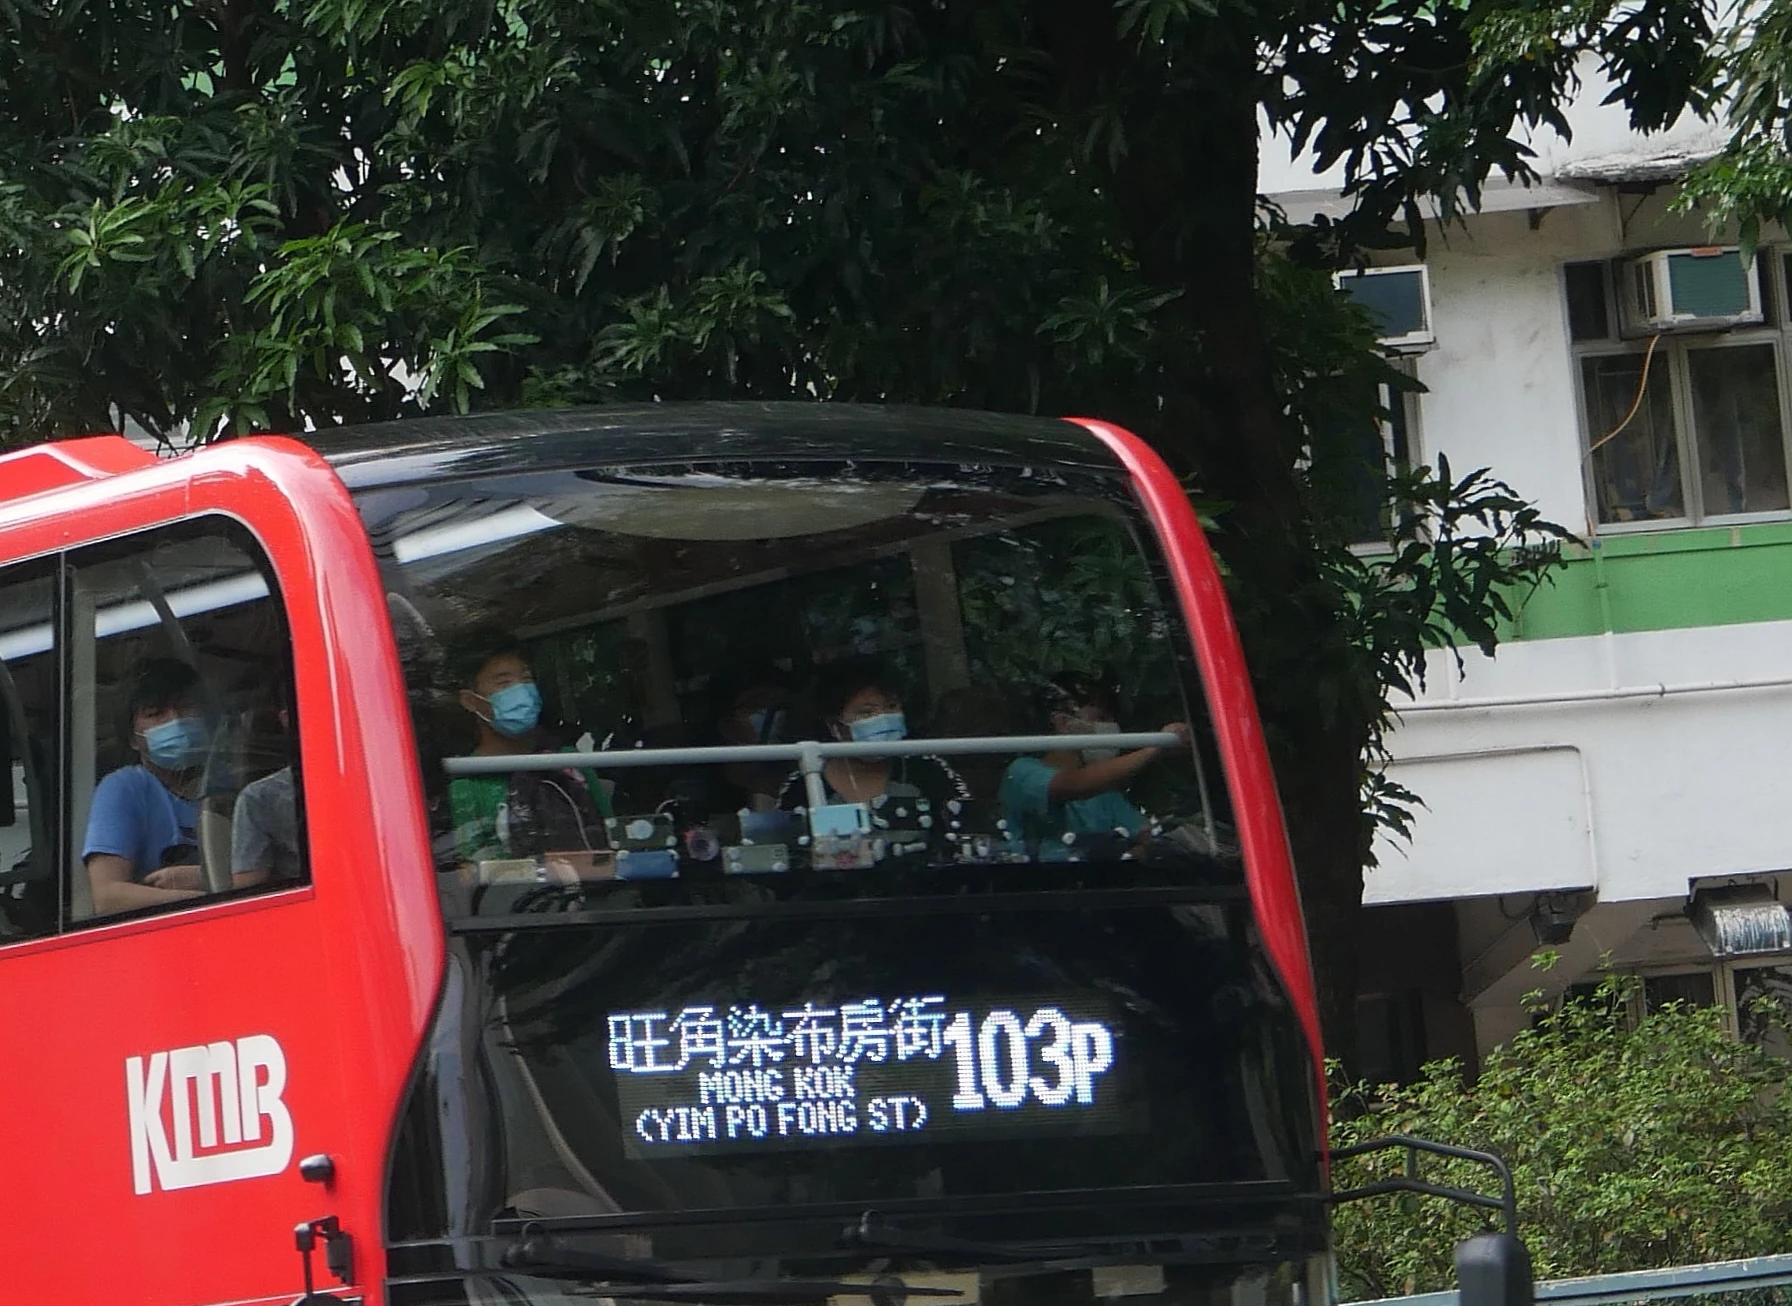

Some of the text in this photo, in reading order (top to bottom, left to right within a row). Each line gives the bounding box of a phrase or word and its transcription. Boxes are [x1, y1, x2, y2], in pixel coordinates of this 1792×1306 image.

[608, 996, 947, 1073] 旺角染布房街
[943, 1008, 1113, 1110] 103P
[125, 1034, 295, 1195] KMB
[636, 1096, 928, 1142] (YIM PO FONG ST)
[699, 1065, 856, 1105] MONG KOK
